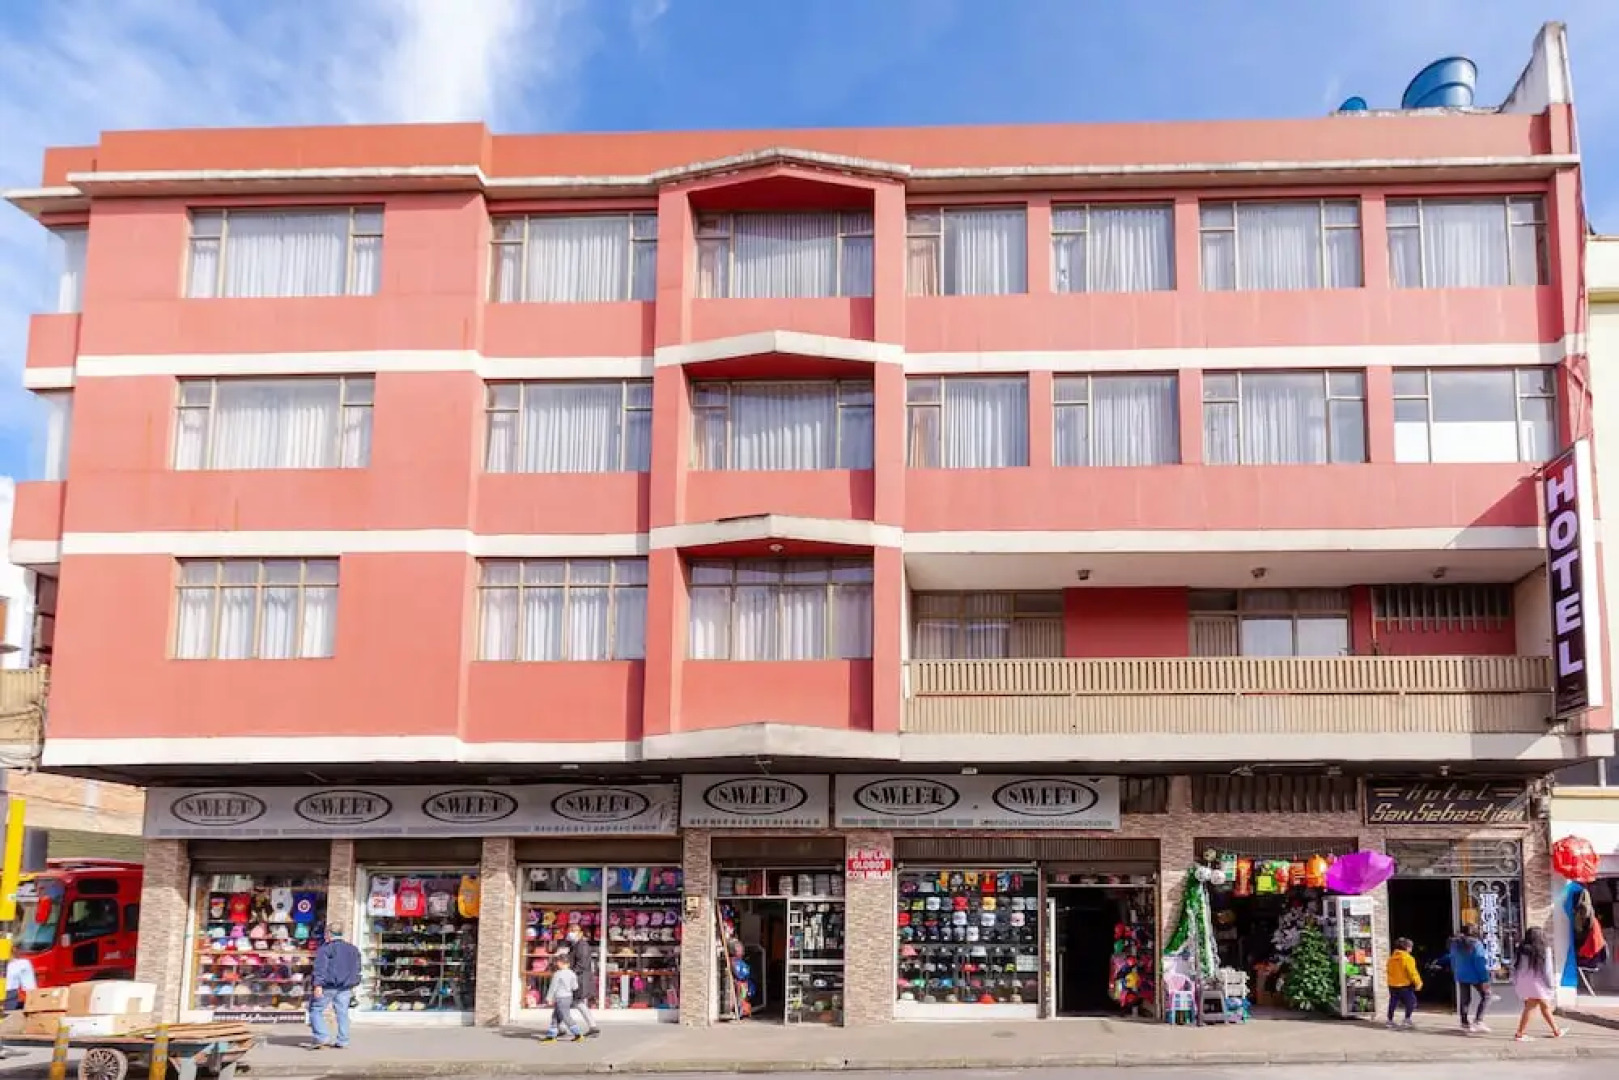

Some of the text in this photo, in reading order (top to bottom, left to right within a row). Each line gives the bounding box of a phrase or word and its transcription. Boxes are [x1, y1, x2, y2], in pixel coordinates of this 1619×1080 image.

[1547, 465, 1583, 677] HOTEL
[711, 785, 793, 804] SWEET
[1004, 786, 1084, 804] SWEET
[181, 799, 254, 816] SWEET
[306, 797, 378, 815] SWEET
[432, 796, 505, 814] SWEET
[562, 795, 635, 813] SWEET
[1370, 802, 1412, 822] San
